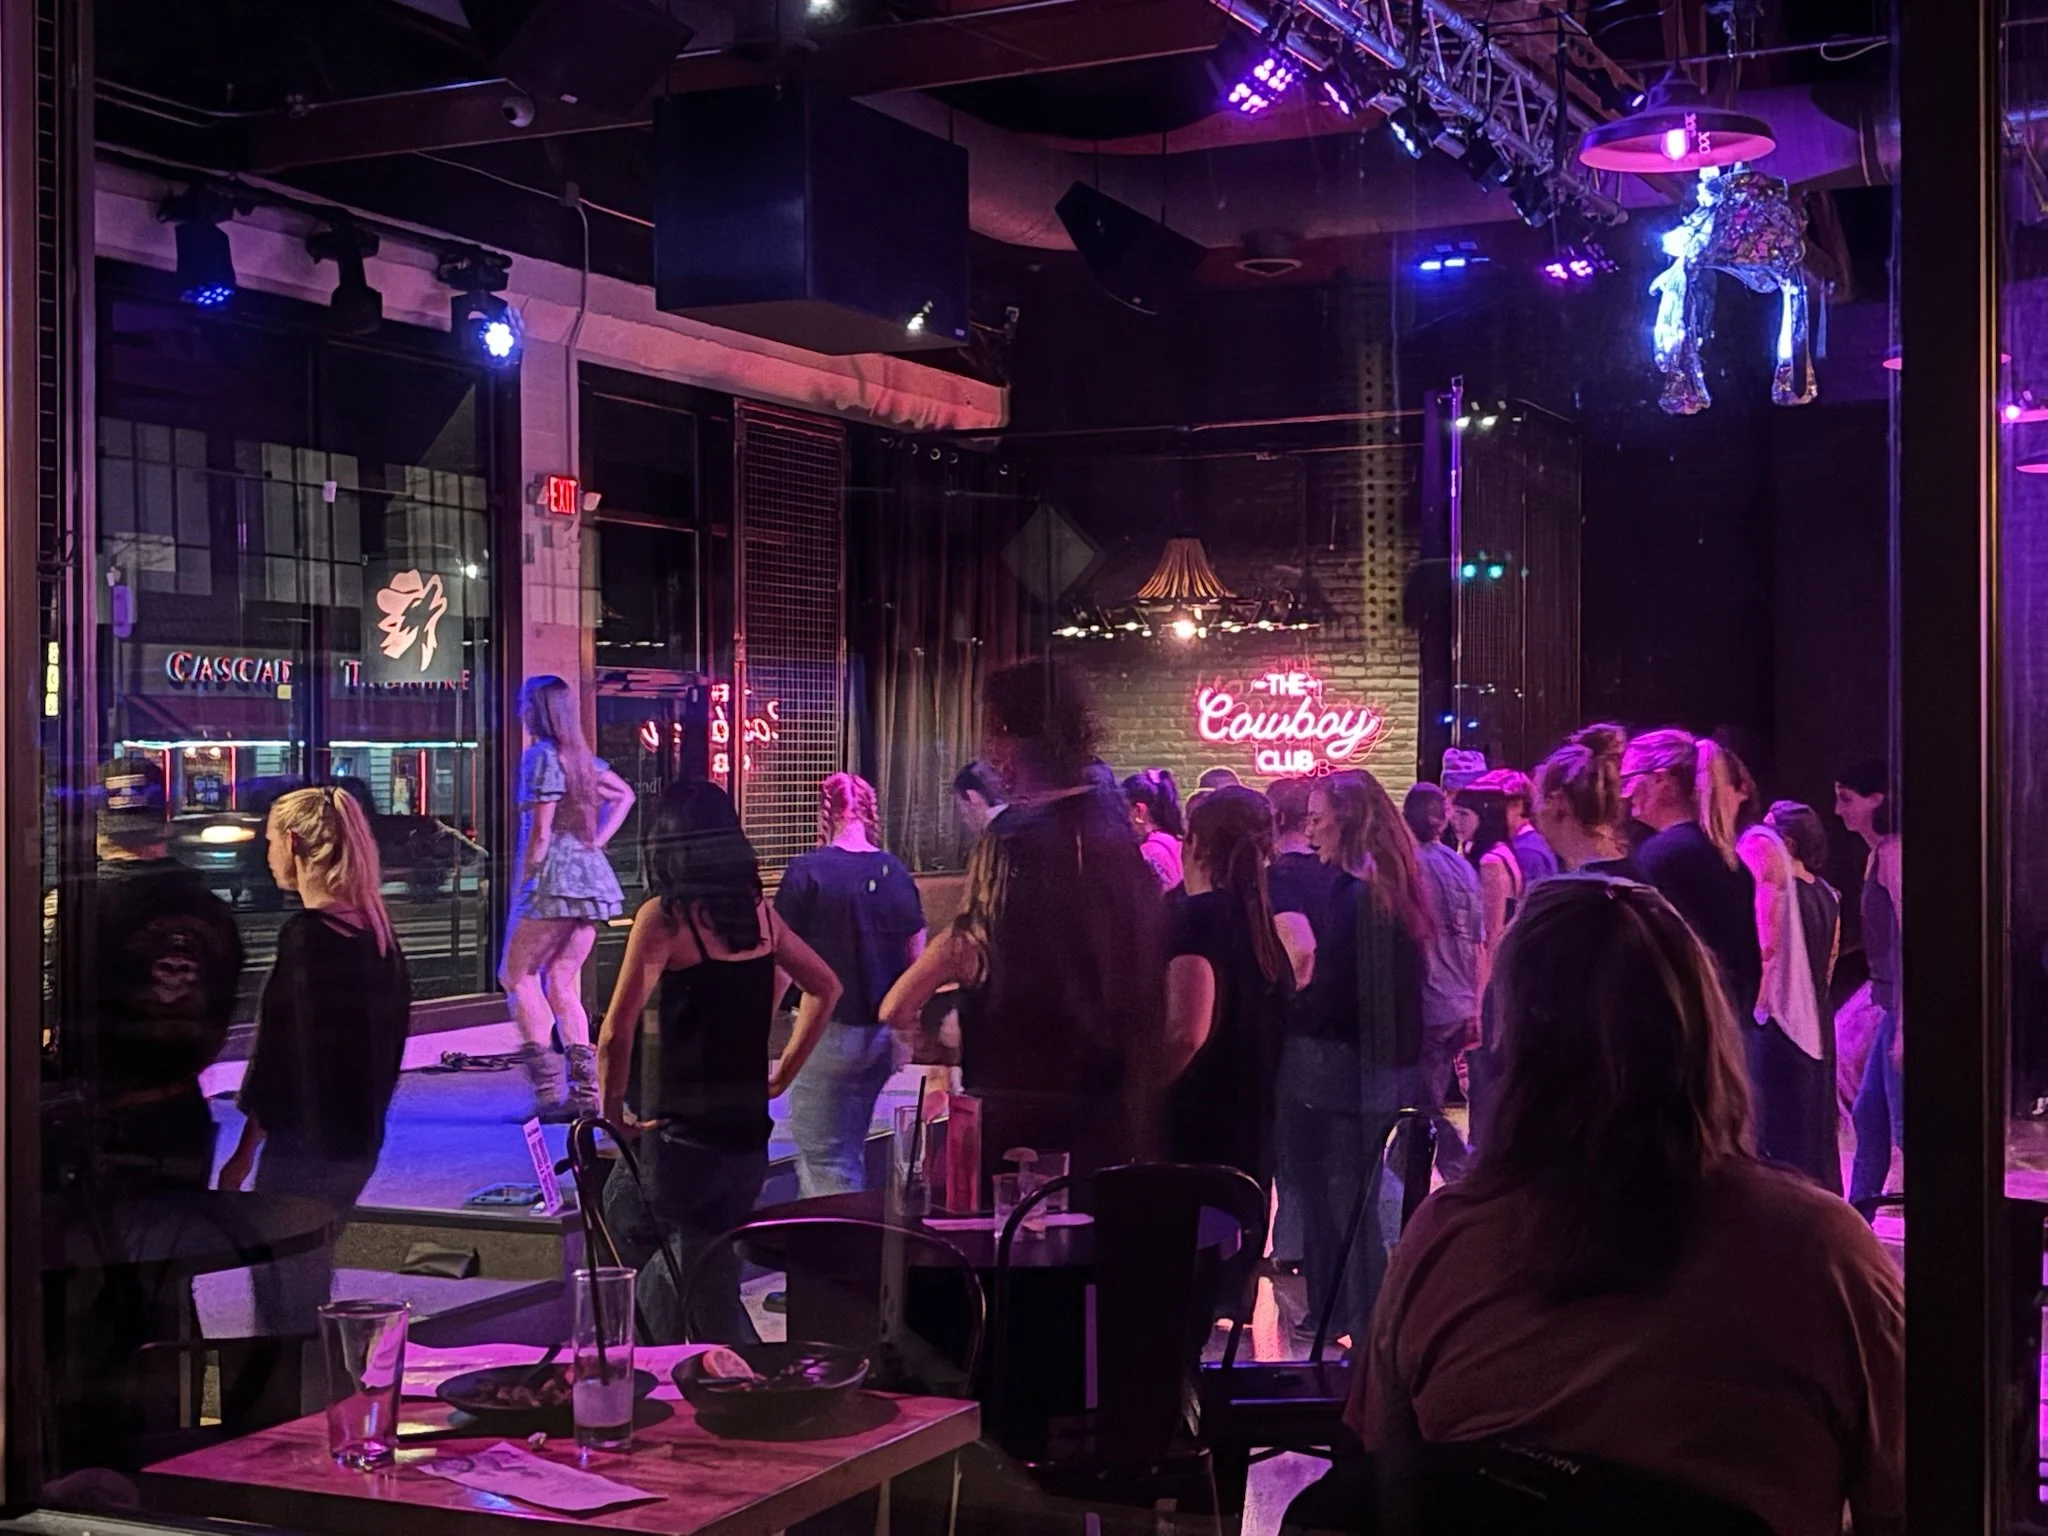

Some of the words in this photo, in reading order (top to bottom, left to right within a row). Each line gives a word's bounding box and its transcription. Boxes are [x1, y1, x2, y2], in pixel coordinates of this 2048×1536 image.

[549, 476, 577, 514] EXIT
[165, 650, 294, 684] CASCAD
[1265, 672, 1307, 696] THE
[1197, 687, 1380, 759] Cowboy
[1257, 749, 1314, 773] CLUB
